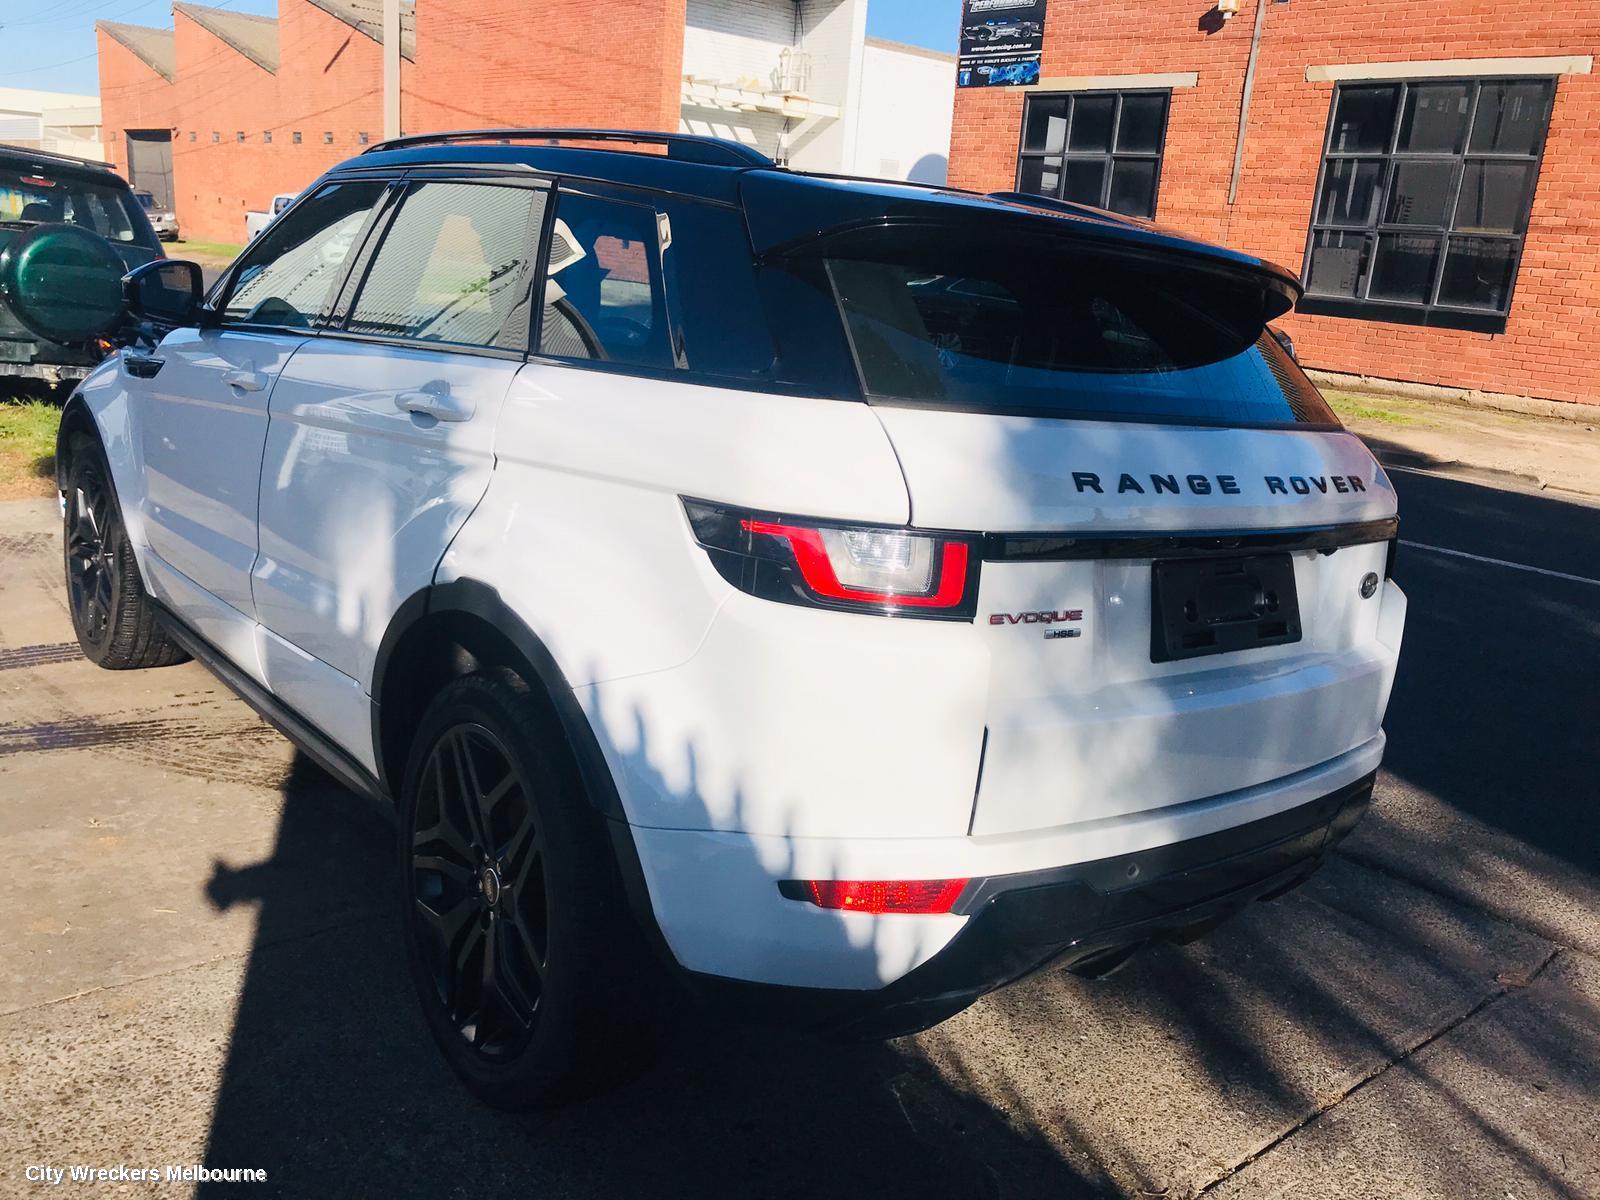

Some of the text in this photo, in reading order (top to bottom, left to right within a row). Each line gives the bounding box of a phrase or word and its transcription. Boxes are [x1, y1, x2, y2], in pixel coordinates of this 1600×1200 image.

[1072, 472, 1366, 495] RANGE ROVER
[989, 609, 1083, 625] EVOQUE
[1053, 629, 1075, 638] HSE
